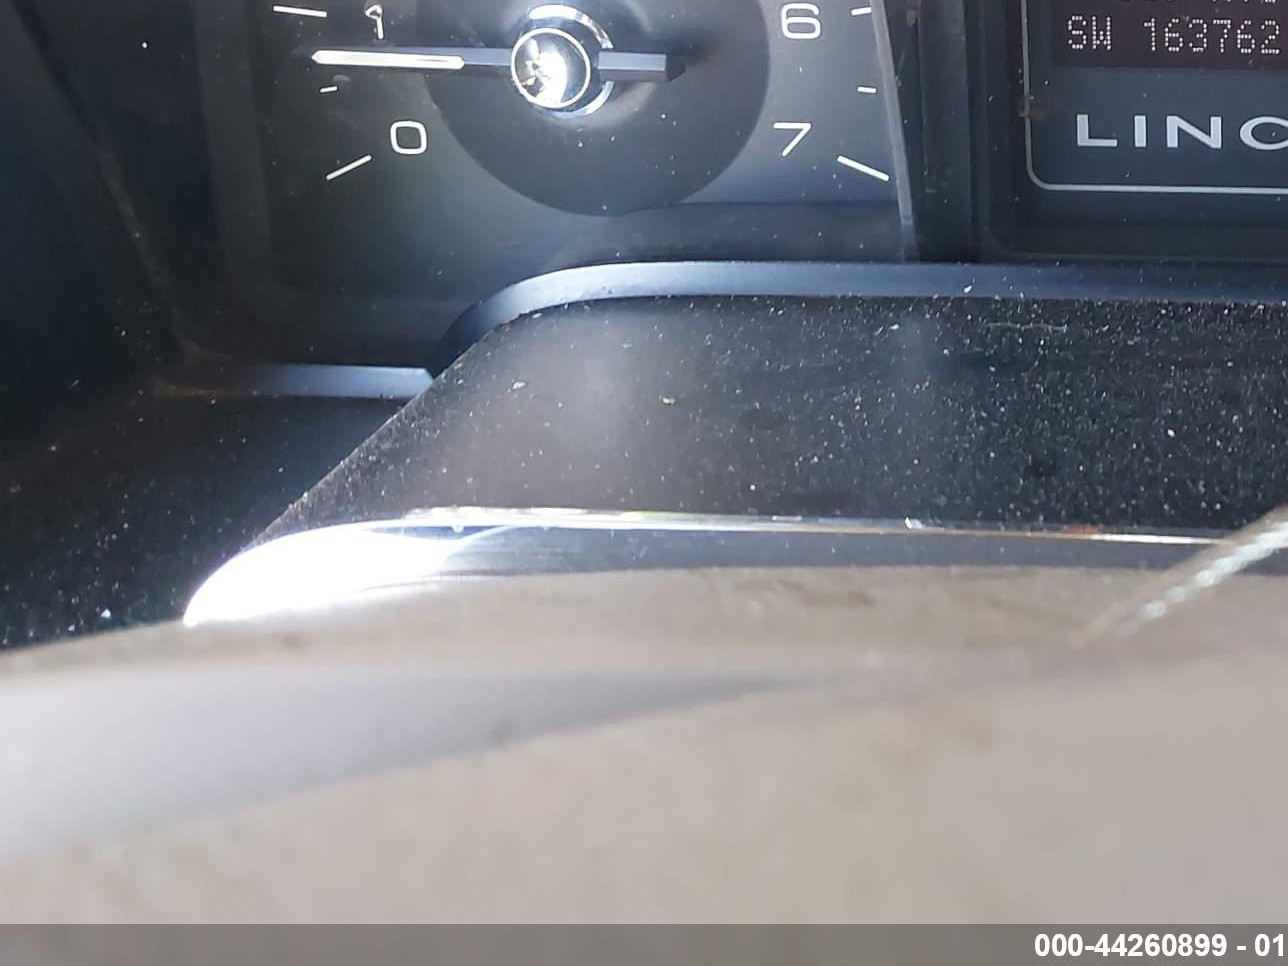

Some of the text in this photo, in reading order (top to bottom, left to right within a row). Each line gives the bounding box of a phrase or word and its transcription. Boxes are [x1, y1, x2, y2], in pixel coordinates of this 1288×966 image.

[364, 4, 384, 40] 1
[780, 2, 821, 40] 6
[1068, 15, 1111, 51] SW
[390, 120, 427, 155] 0
[773, 122, 812, 157] 7
